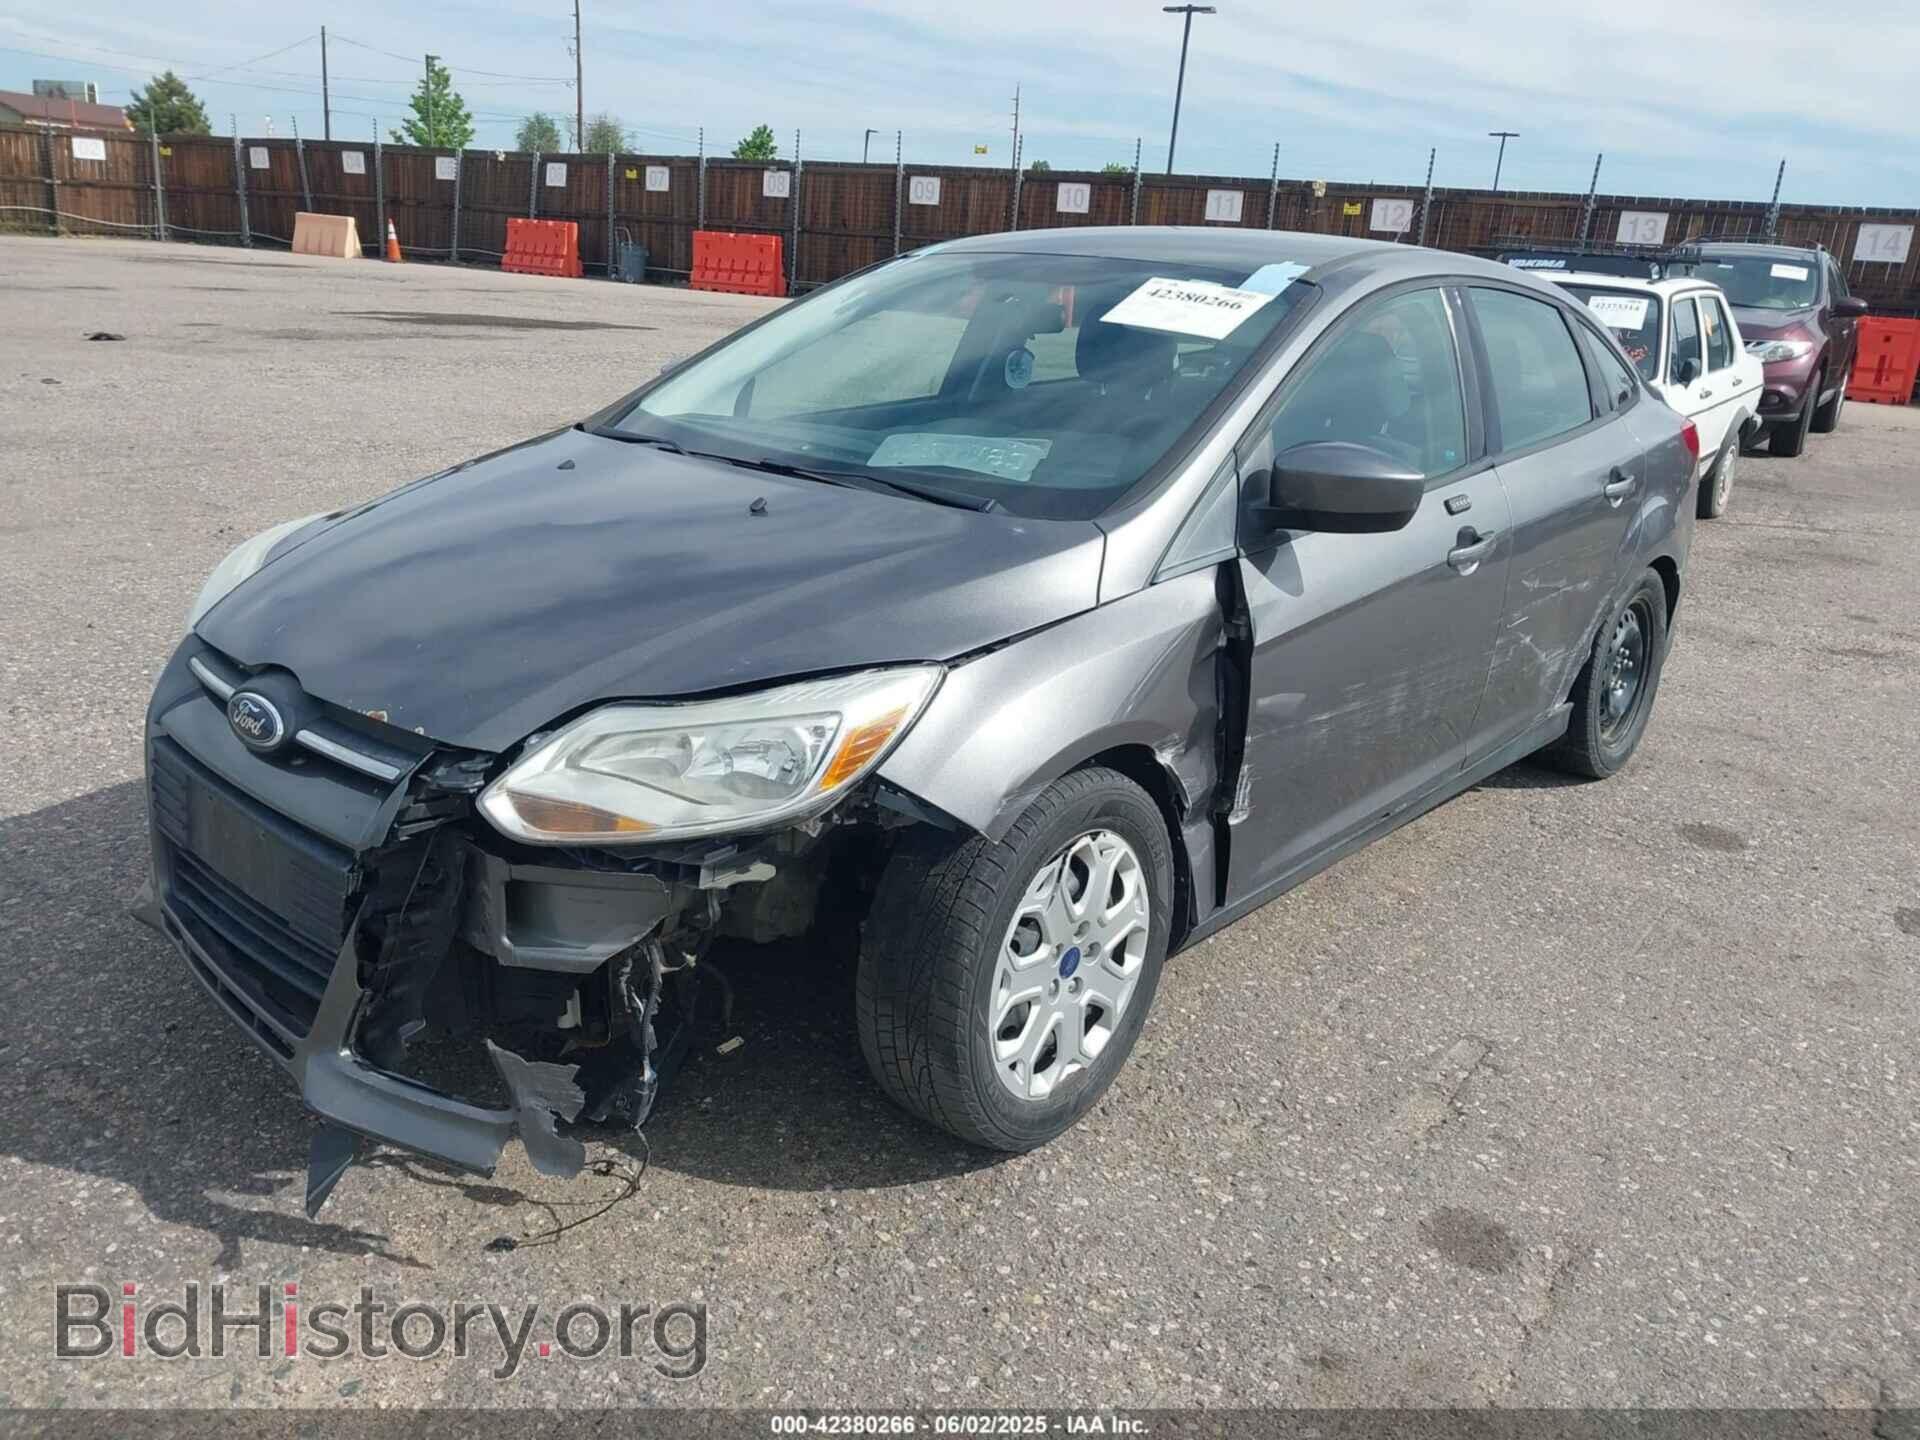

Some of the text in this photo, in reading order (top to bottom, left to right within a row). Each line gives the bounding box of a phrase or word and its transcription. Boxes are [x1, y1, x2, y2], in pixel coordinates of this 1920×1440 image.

[649, 170, 666, 187] 07
[767, 175, 785, 193] 08
[914, 181, 935, 200] 09
[1064, 188, 1084, 208] 10
[1213, 195, 1233, 216] 11
[1379, 204, 1404, 226] 12
[1628, 216, 1657, 241] 13
[1867, 230, 1901, 257] 14
[1508, 259, 1566, 268] YAKIMA
[1146, 287, 1242, 310] 42380266
[233, 699, 266, 736] Ford
